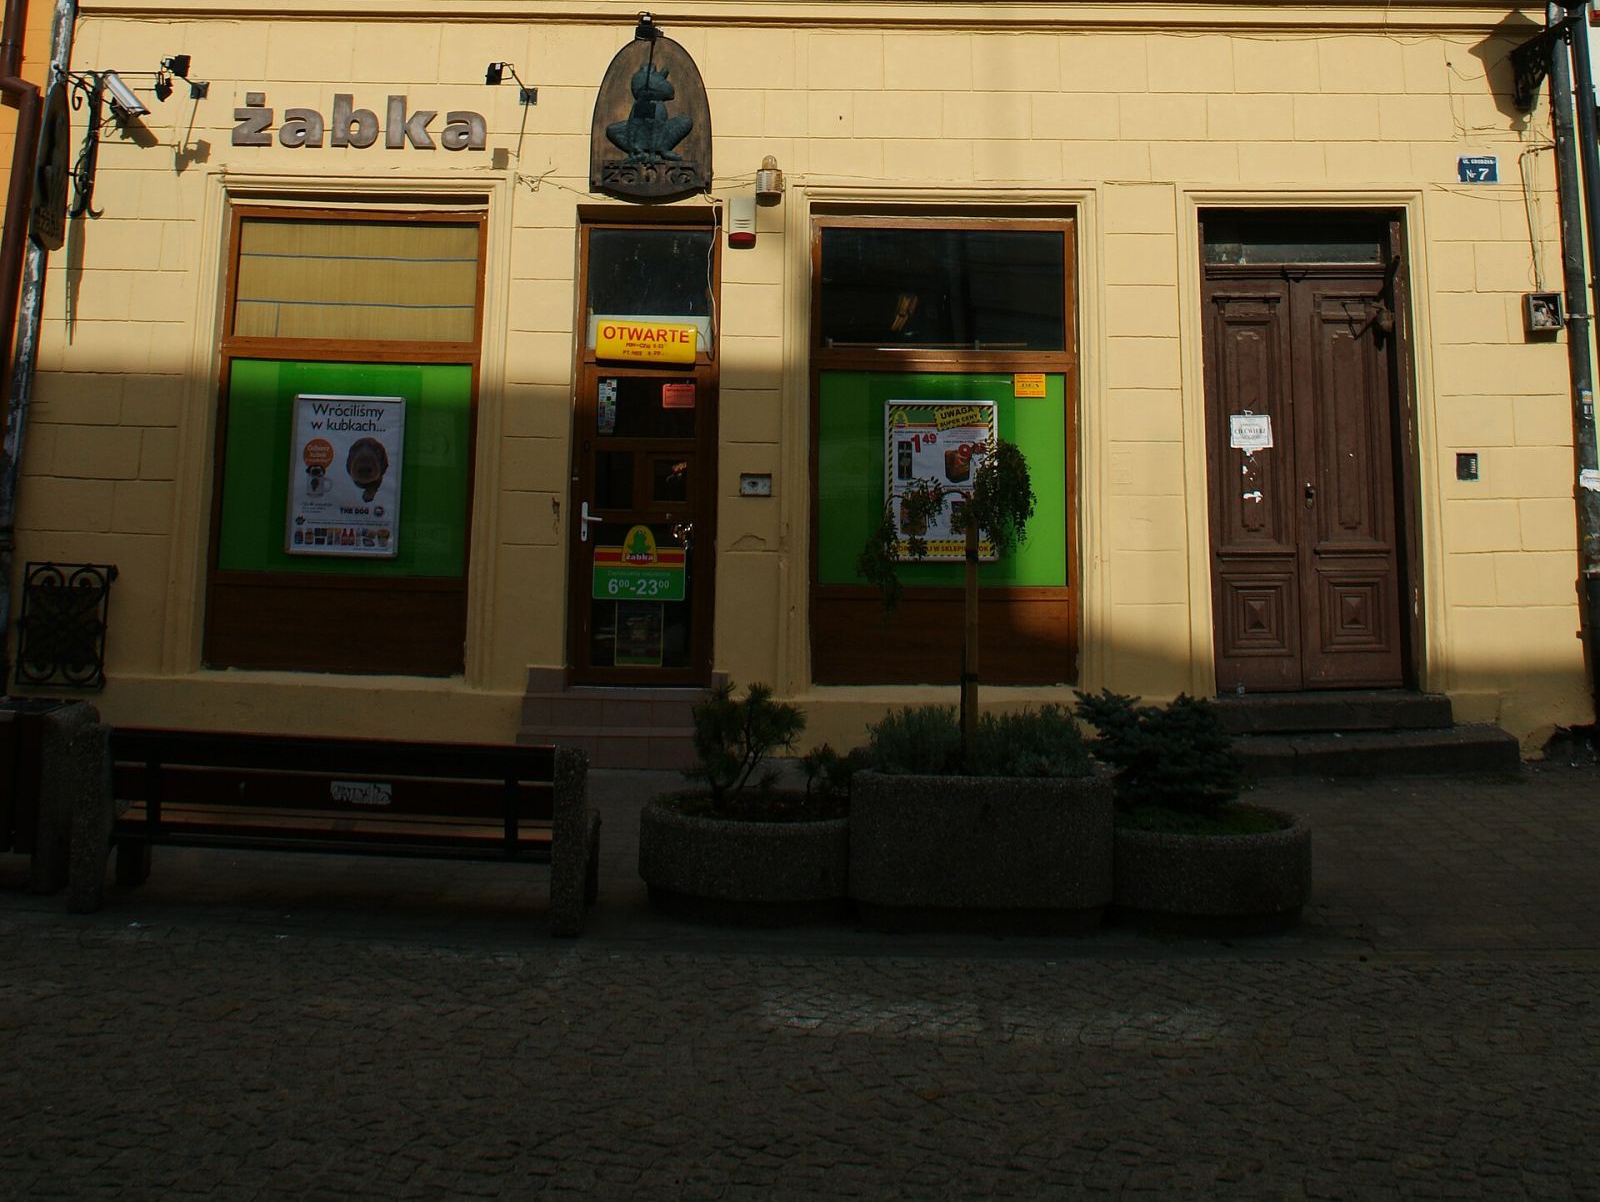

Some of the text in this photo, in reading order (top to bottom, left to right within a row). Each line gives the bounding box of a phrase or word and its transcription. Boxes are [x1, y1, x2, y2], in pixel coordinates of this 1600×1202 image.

[232, 92, 488, 151] żabka
[1479, 168, 1490, 180] 7
[603, 326, 690, 344] OTWARTE
[312, 403, 385, 421] Wróciliśmy
[940, 406, 974, 420] UWAGA
[311, 419, 387, 433] w kubkach...
